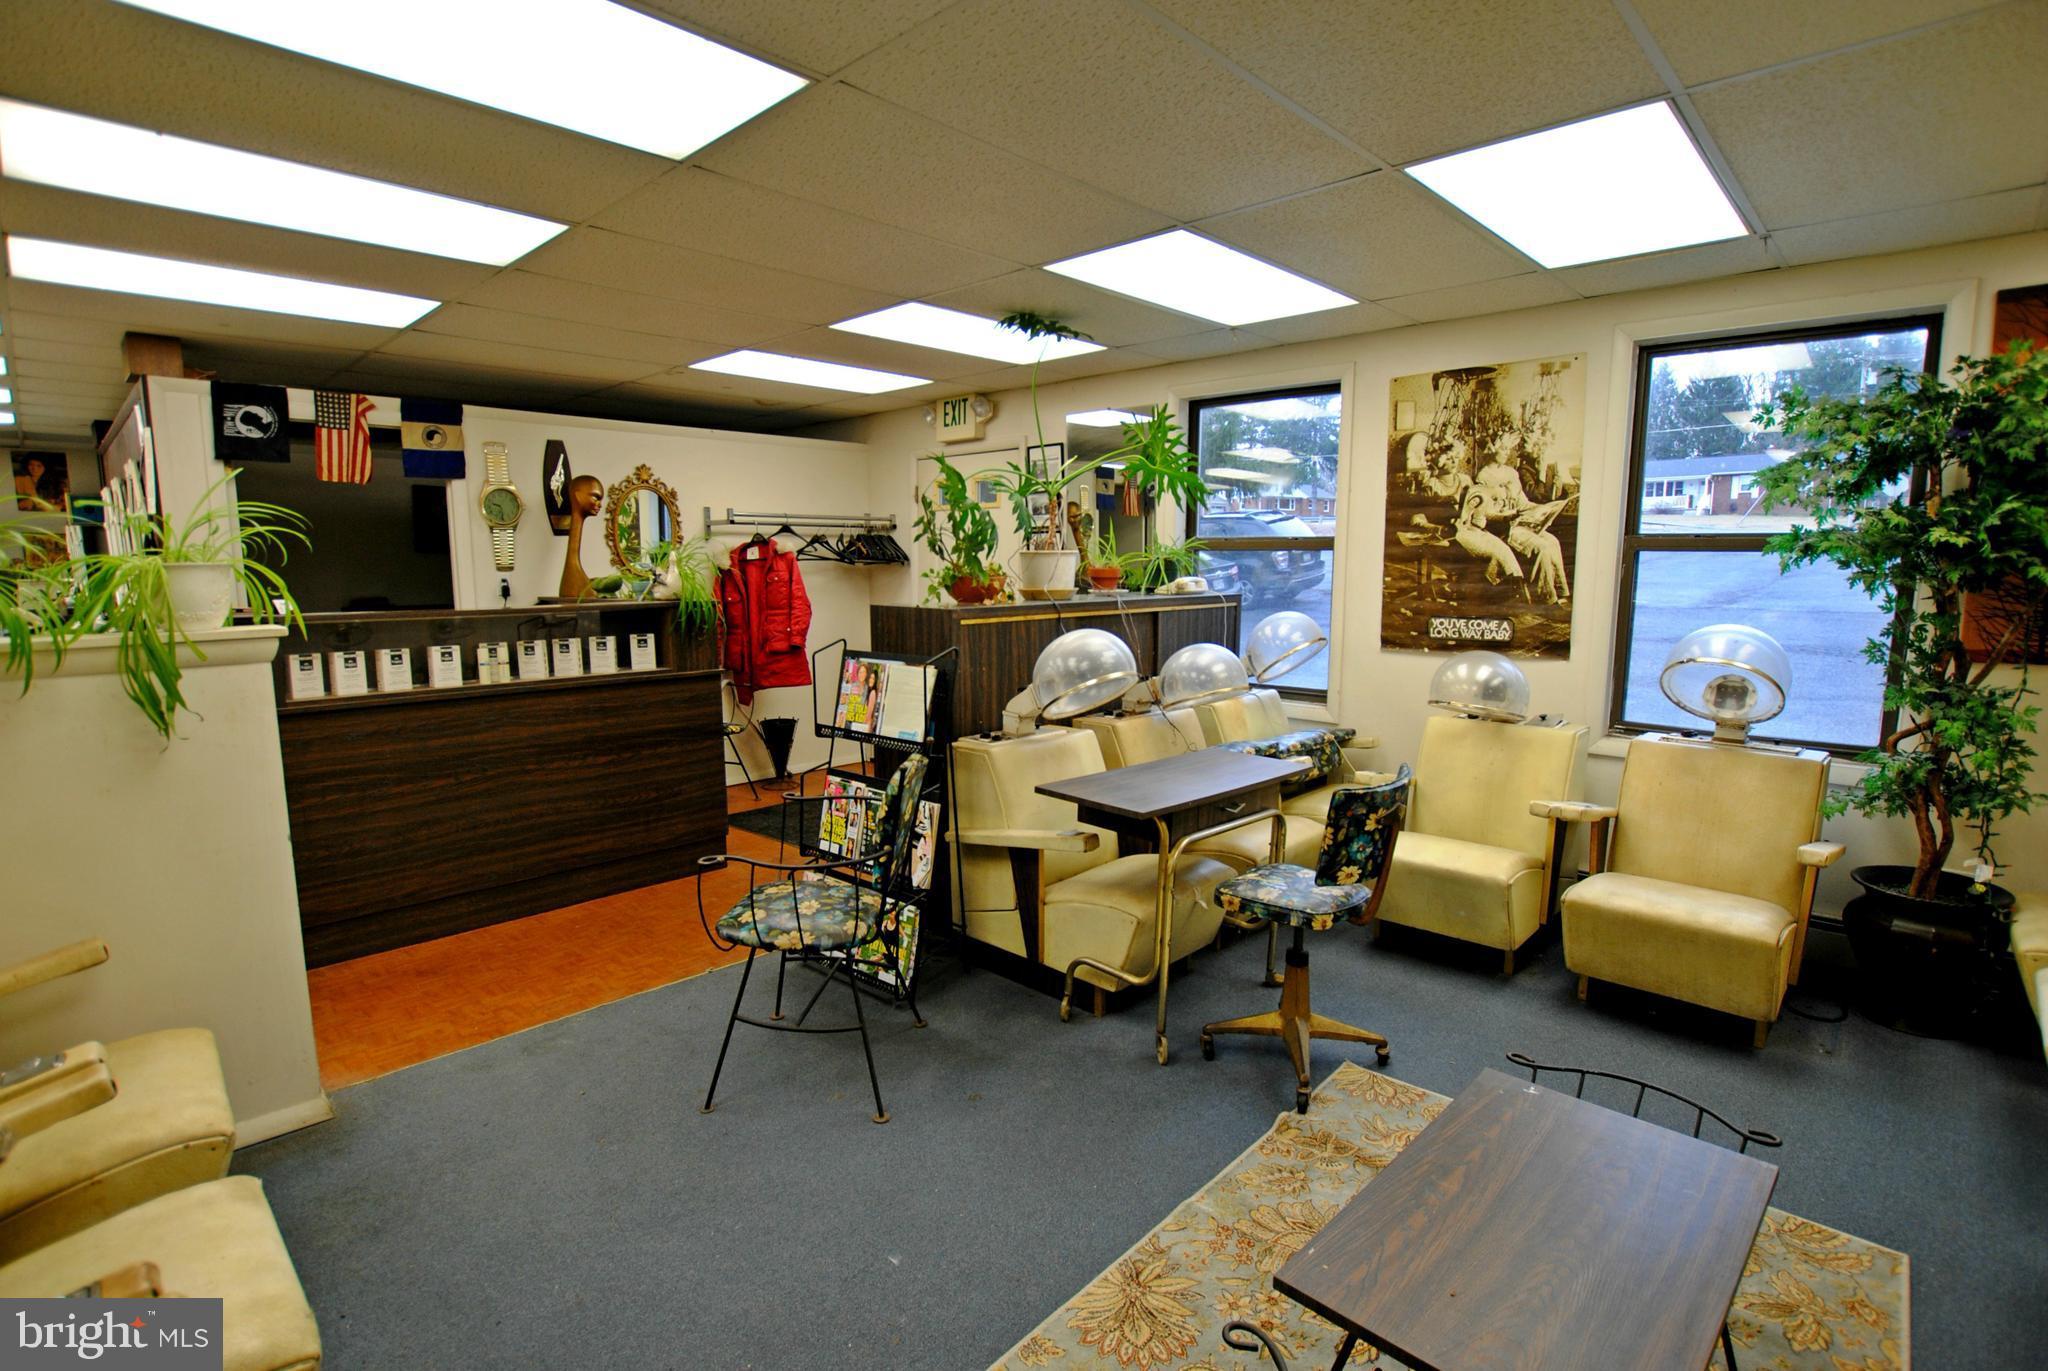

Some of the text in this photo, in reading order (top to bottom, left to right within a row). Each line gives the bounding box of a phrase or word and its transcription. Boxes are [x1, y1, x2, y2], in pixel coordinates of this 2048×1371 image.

[944, 398, 968, 427] EXIT
[1431, 618, 1510, 631] YOU'VE COME A
[1430, 628, 1459, 638] LONG
[1460, 629, 1483, 640] WAY,
